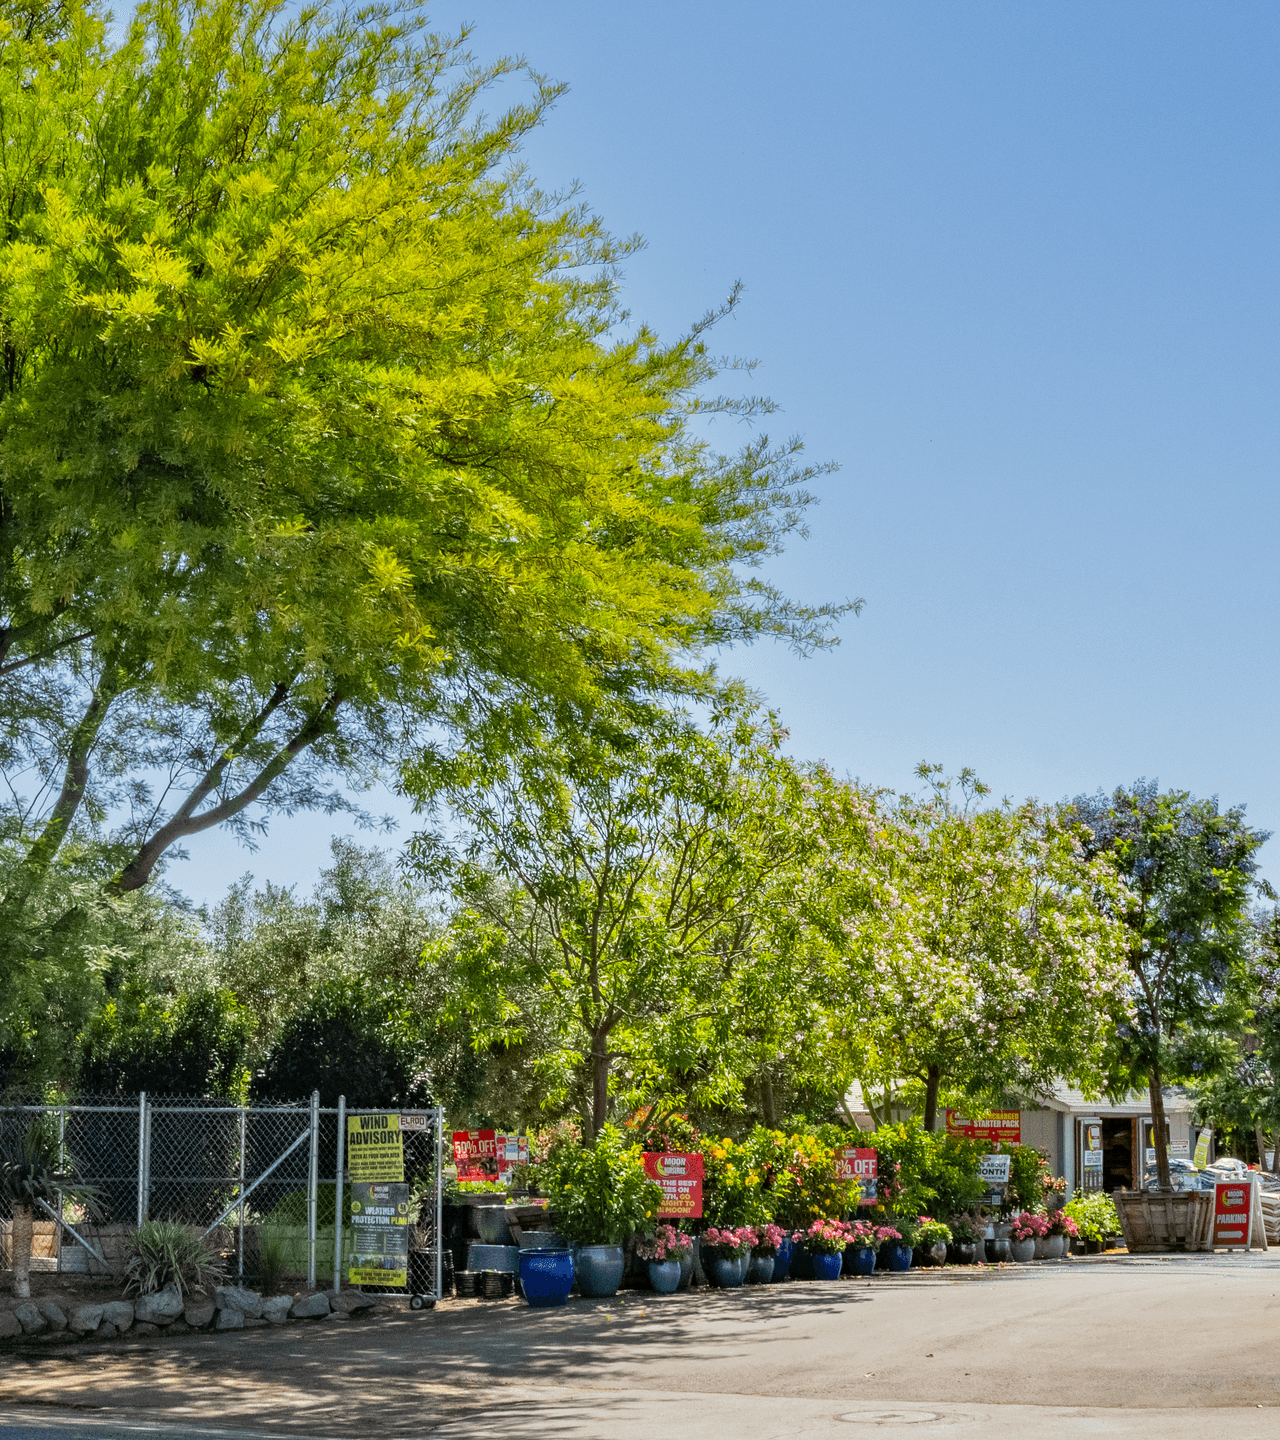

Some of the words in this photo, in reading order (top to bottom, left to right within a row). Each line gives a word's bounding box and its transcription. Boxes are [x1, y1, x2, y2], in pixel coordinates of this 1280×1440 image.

[360, 1115, 389, 1130] WIND
[400, 1117, 425, 1126] ELROD
[973, 1120, 1001, 1128] STARTER
[1002, 1120, 1020, 1128] PACK
[349, 1130, 401, 1146] ADVISORY
[454, 1141, 477, 1154] 50%
[478, 1139, 495, 1153] OFF
[664, 1157, 686, 1165] MOON
[854, 1159, 876, 1174] OFF
[365, 1206, 395, 1215] WEATHER
[351, 1215, 390, 1225] PROTECTION
[391, 1216, 408, 1225] PLAN
[1216, 1213, 1247, 1224] PARKING
